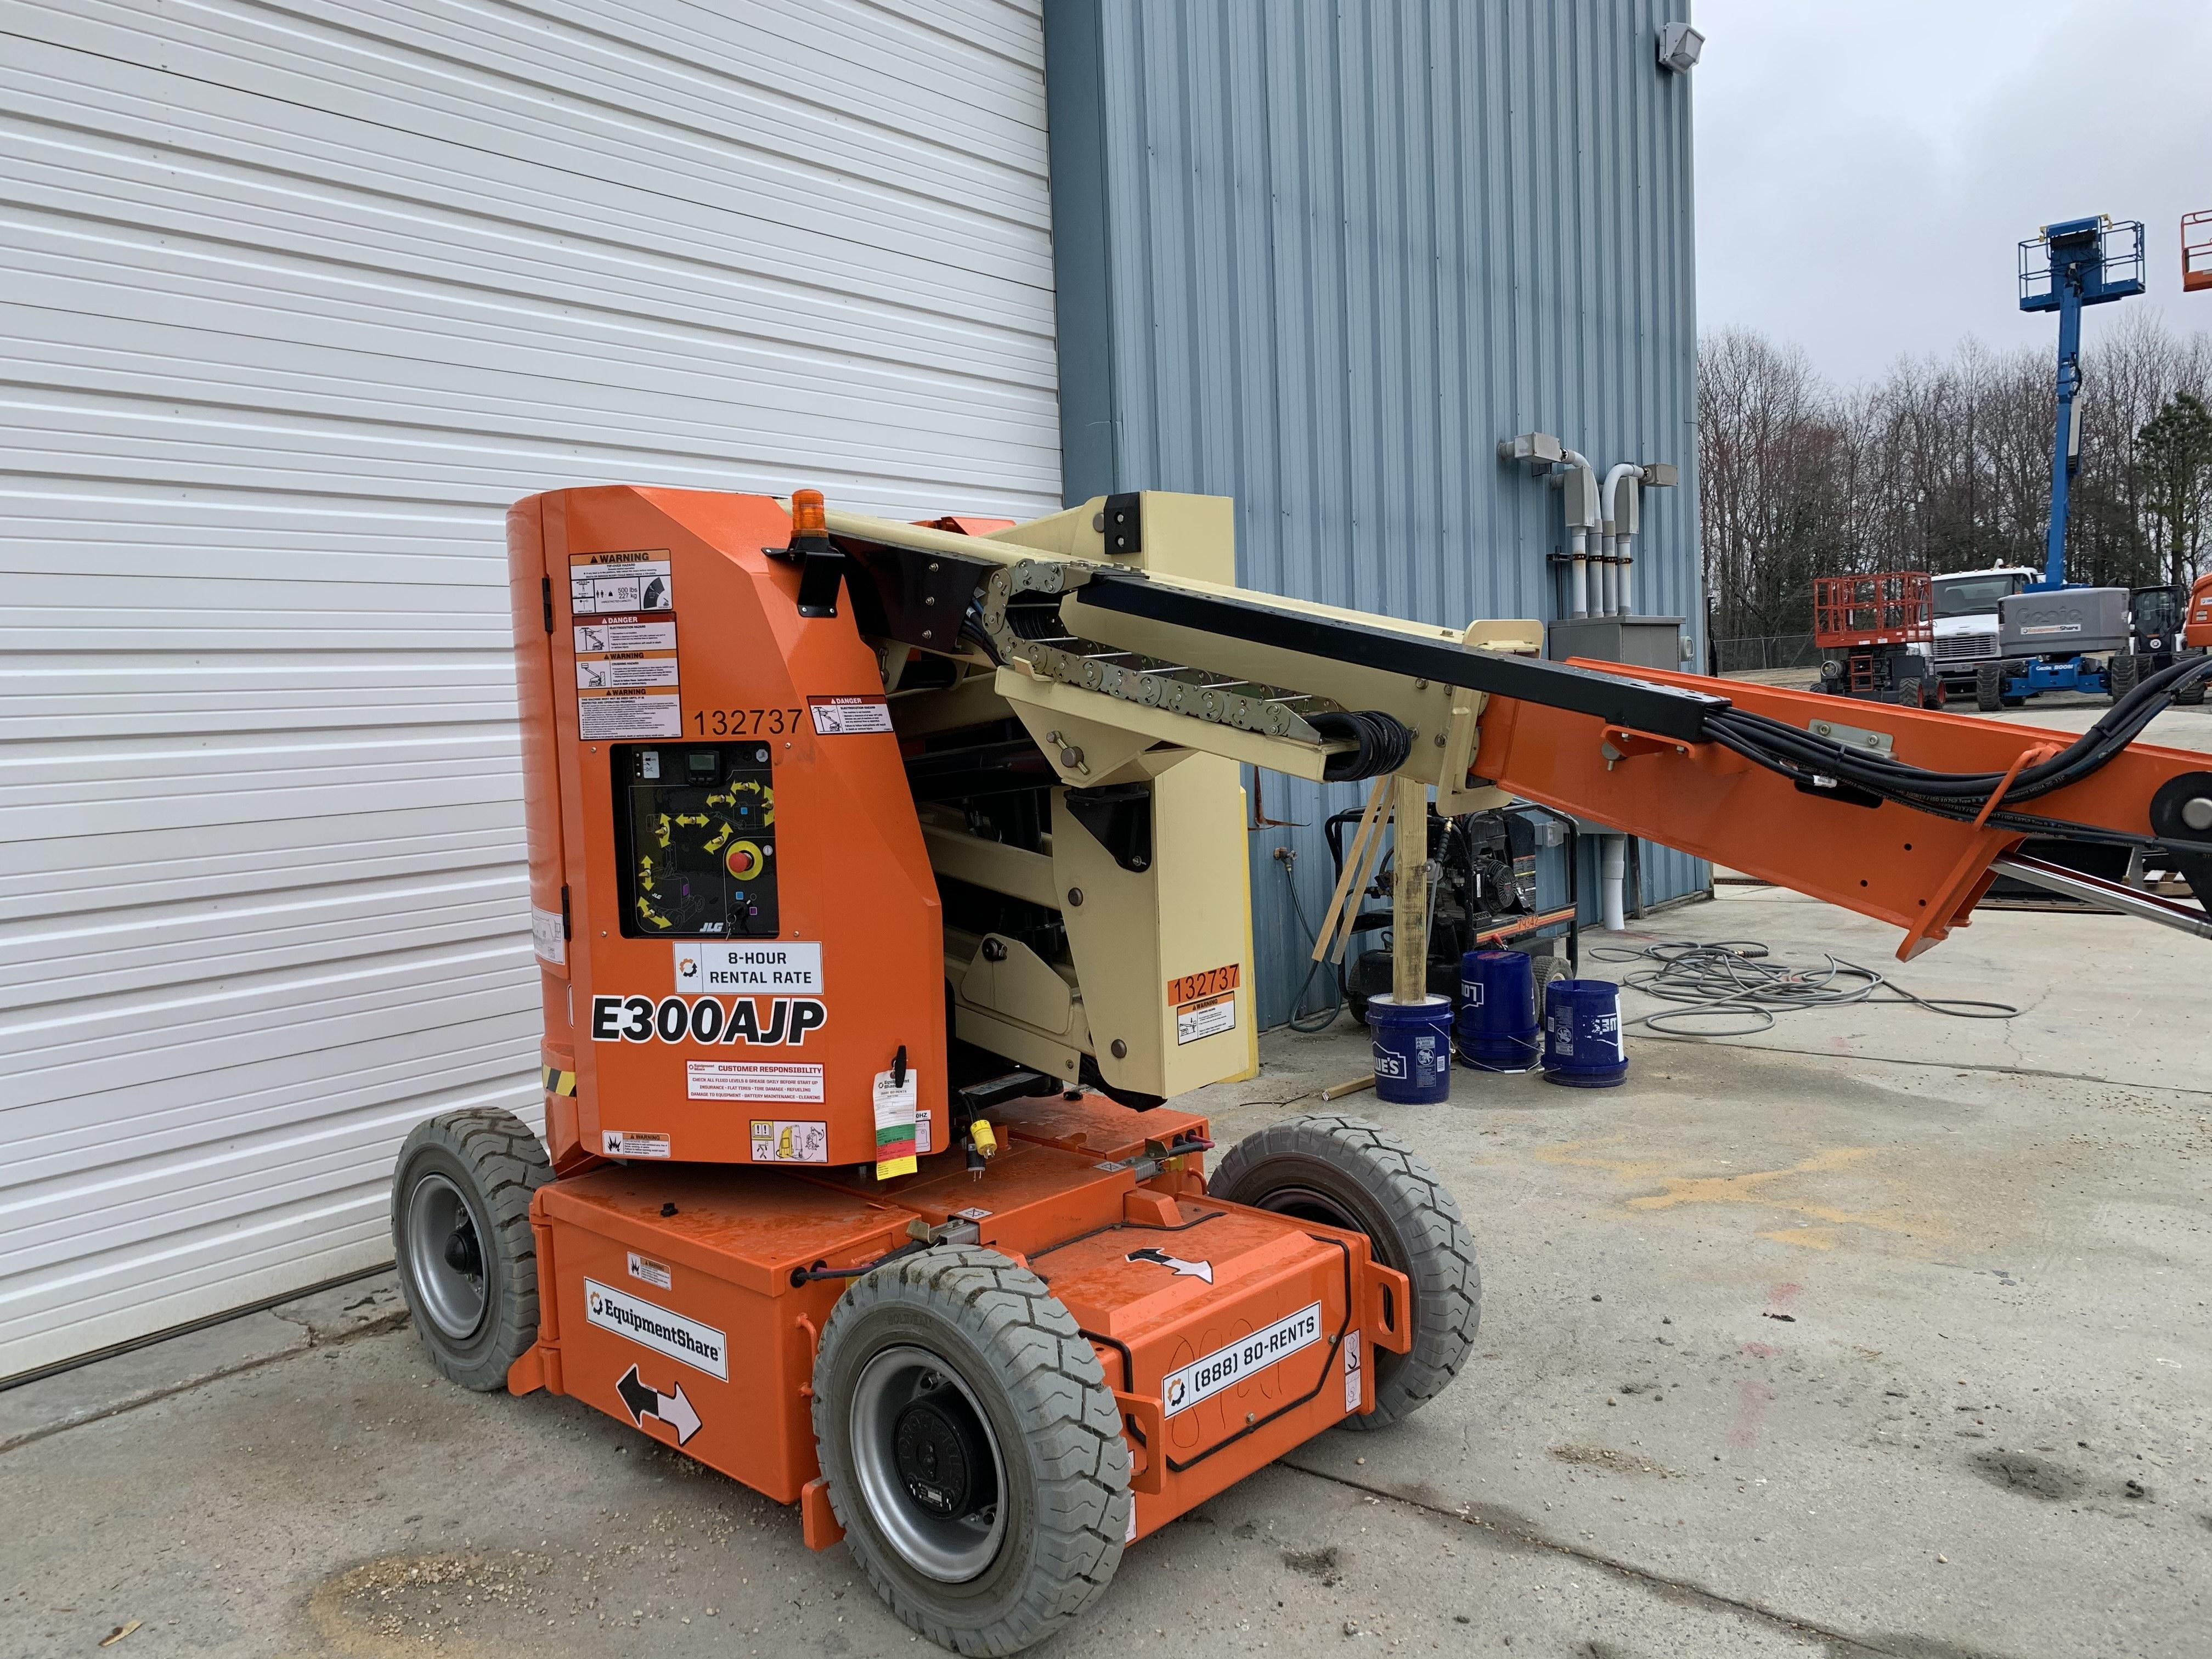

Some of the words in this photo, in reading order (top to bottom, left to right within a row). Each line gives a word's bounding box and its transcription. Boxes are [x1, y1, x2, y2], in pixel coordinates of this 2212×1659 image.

[600, 552, 649, 563] WARNING
[695, 709, 802, 735] 132737
[699, 922, 724, 932] JLG
[728, 952, 787, 964] 8-HOUR
[710, 971, 768, 984] RENTAL
[773, 971, 812, 984] RATE
[1175, 964, 1238, 1002] 132737
[1197, 998, 1217, 1009] WARNING
[591, 995, 827, 1046] E300AJP
[1374, 1056, 1398, 1075] WE'S
[605, 1299, 719, 1362] EquipmentShare
[1195, 1353, 1238, 1392] (888)
[1244, 1316, 1314, 1365] 80-RENTS
